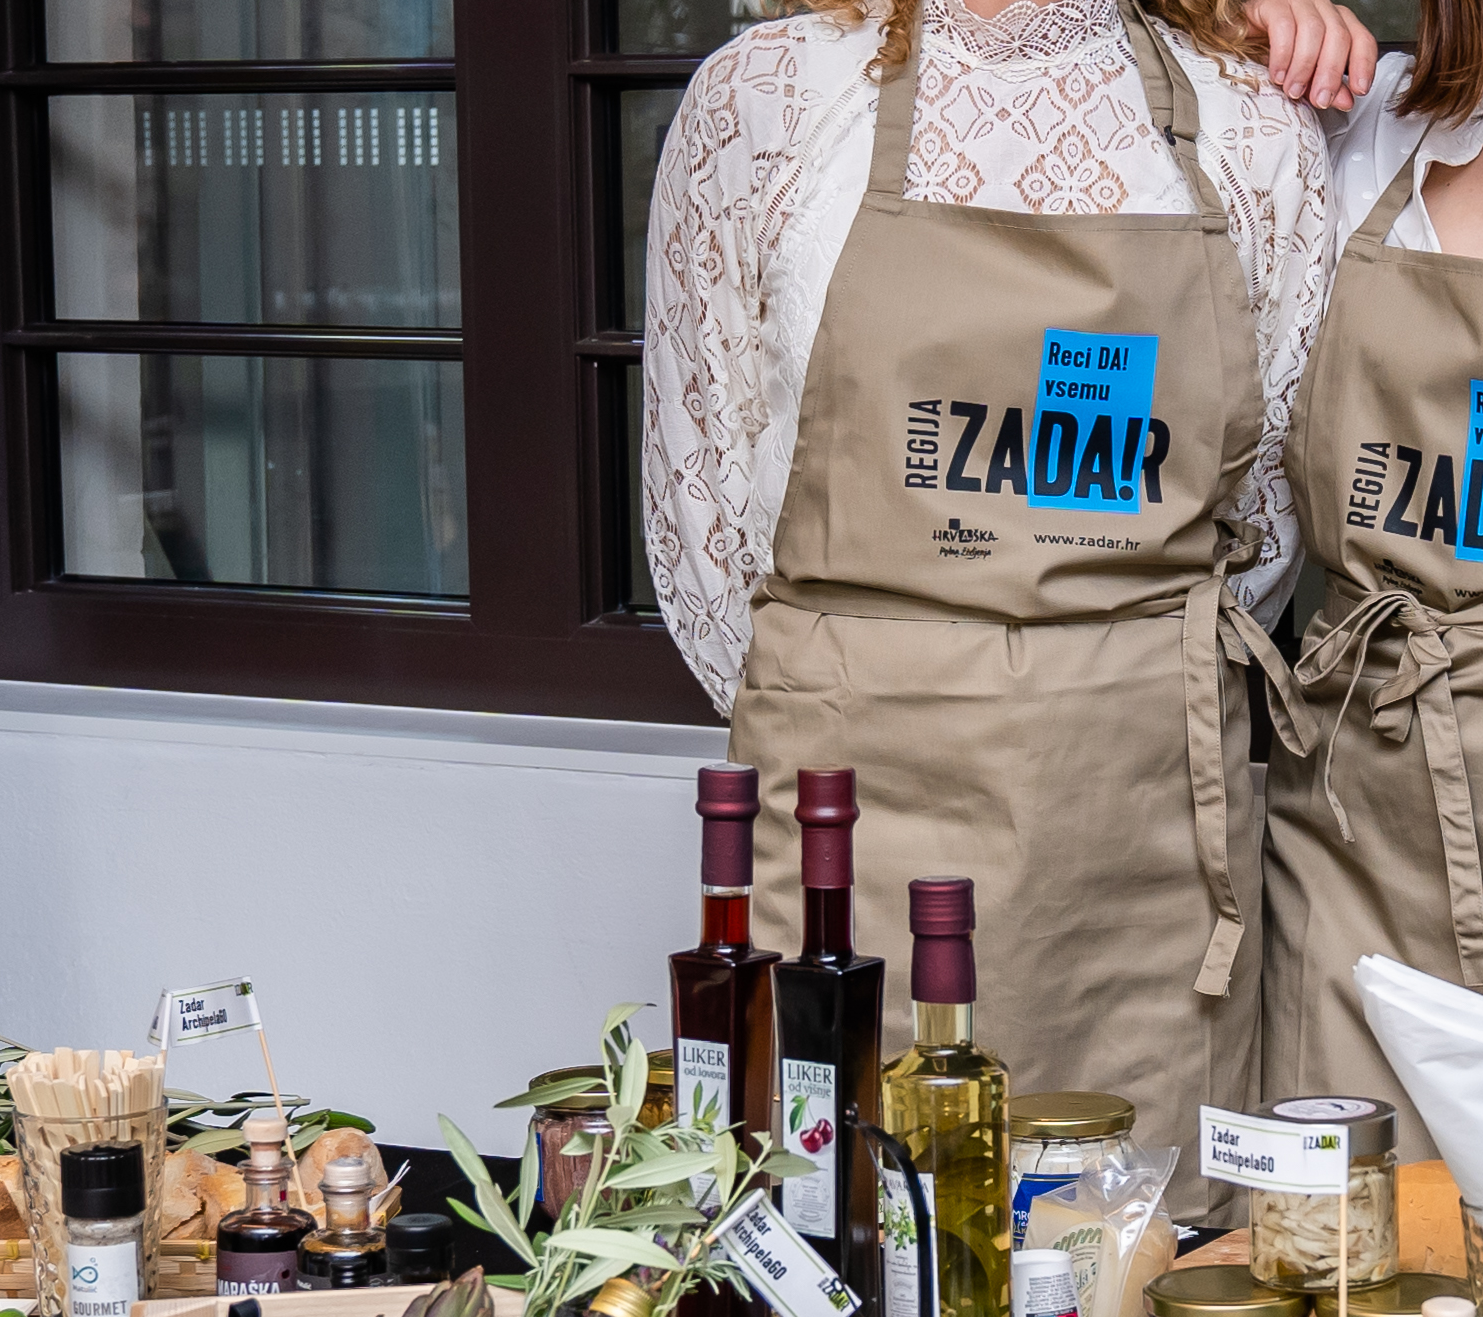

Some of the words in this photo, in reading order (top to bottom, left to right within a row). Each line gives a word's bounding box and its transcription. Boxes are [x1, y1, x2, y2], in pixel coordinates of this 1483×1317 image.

[1048, 341, 1093, 369] Reci
[1098, 346, 1131, 372] DA!
[1045, 379, 1111, 401] vsemu
[904, 399, 942, 490] REGIJA
[1346, 442, 1391, 530] REGIJA
[1034, 533, 1141, 552] www.zadar.hr
[178, 998, 205, 1014] Zadar
[682, 1046, 726, 1067] LIKER
[684, 1065, 698, 1076] od
[699, 1068, 726, 1081] lovora
[787, 1063, 833, 1084] LIKER
[788, 1083, 802, 1093] od
[804, 1084, 832, 1099] višnje
[1211, 1125, 1241, 1147] Zadar
[747, 1205, 772, 1236] Zadar
[73, 1300, 127, 1316] GOURMET
